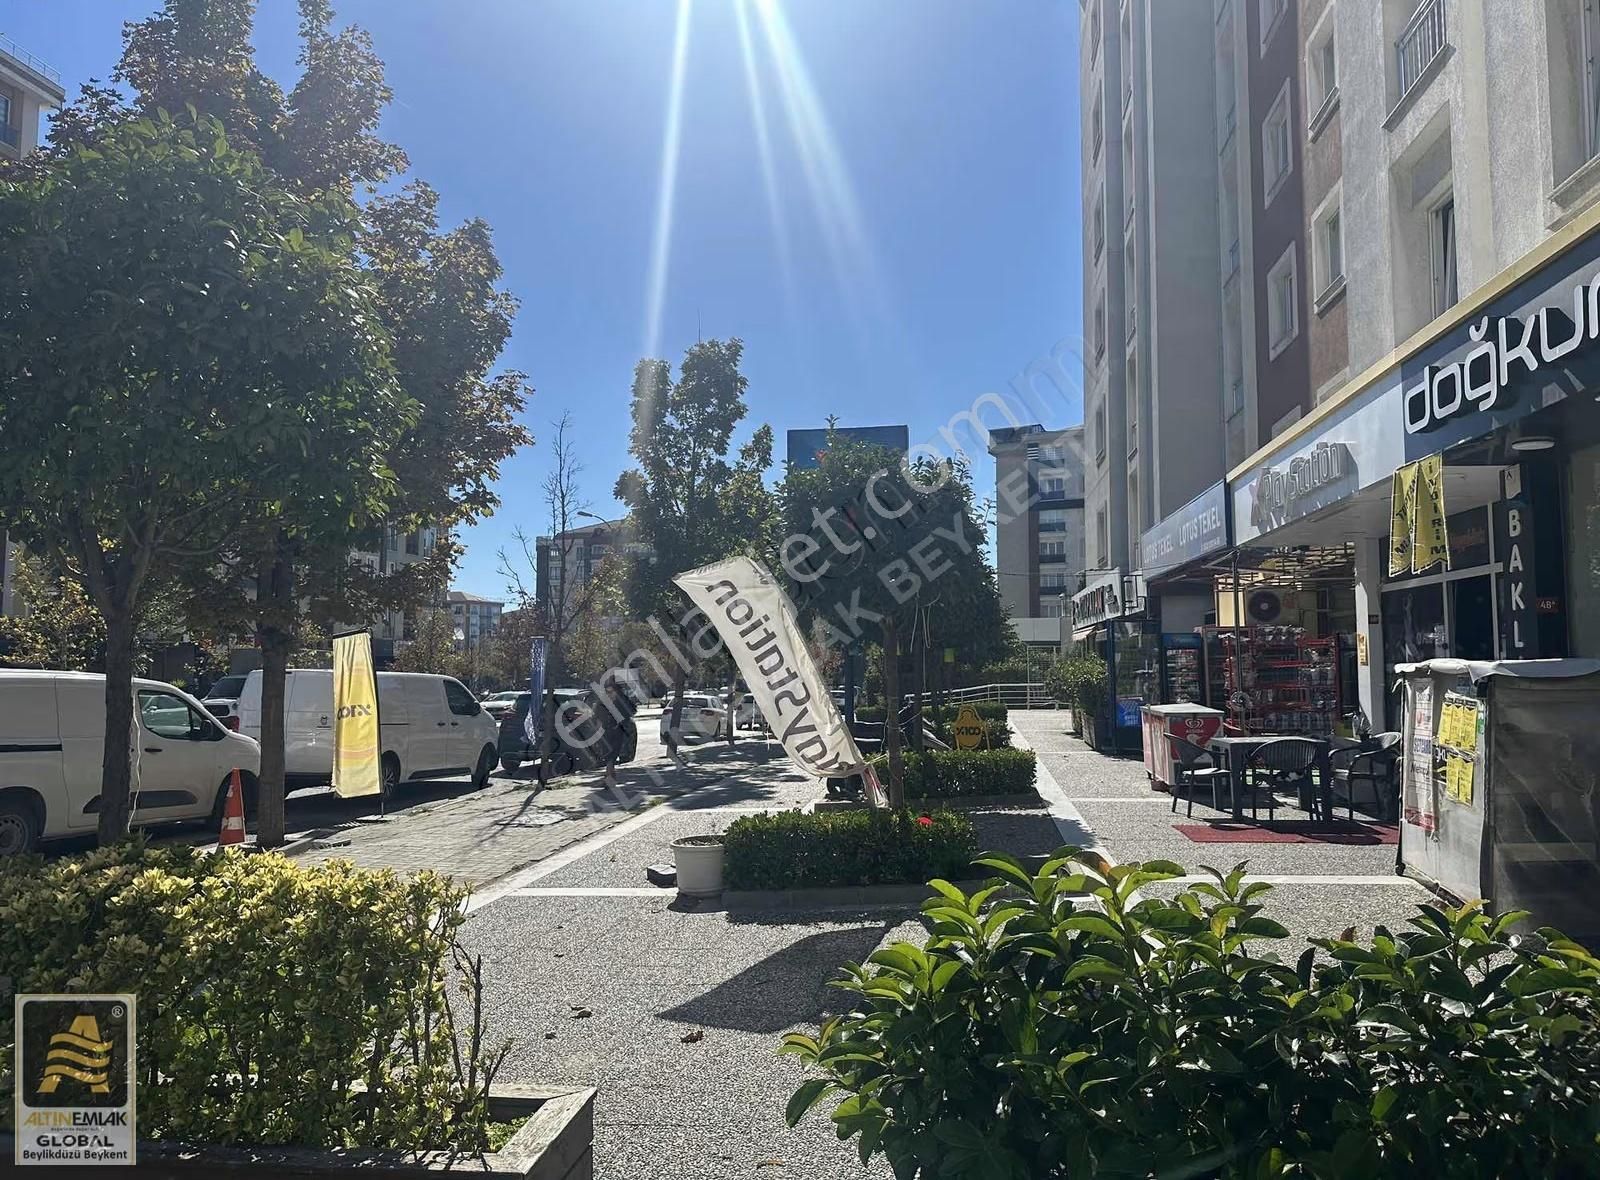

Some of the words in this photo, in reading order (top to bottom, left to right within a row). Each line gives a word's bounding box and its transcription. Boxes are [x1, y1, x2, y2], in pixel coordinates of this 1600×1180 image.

[1179, 515, 1199, 548] LOTUS
[1198, 504, 1221, 537] TEKEL
[1507, 508, 1526, 660] BAKL
